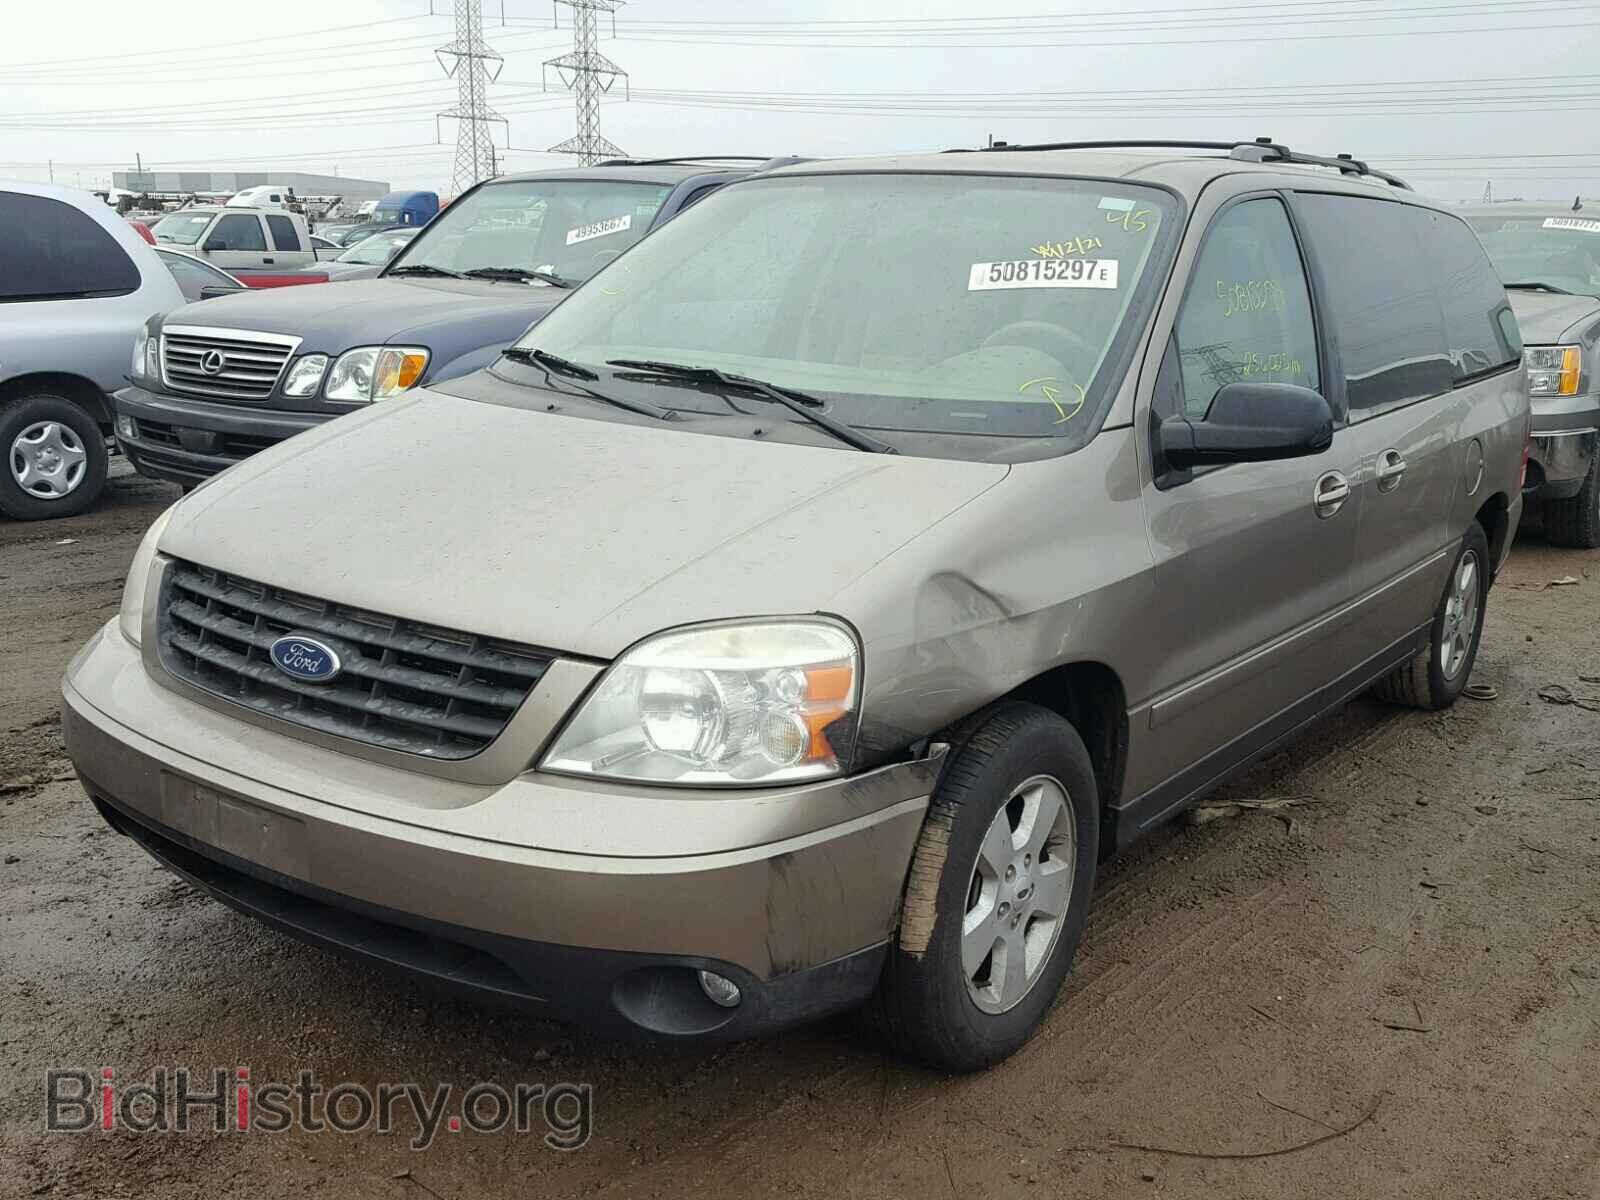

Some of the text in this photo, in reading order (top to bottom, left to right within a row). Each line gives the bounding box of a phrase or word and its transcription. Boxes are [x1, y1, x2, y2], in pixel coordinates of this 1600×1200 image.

[1105, 209, 1151, 231] 45
[989, 260, 1108, 282] 50815297 E
[283, 643, 324, 672] Ford
